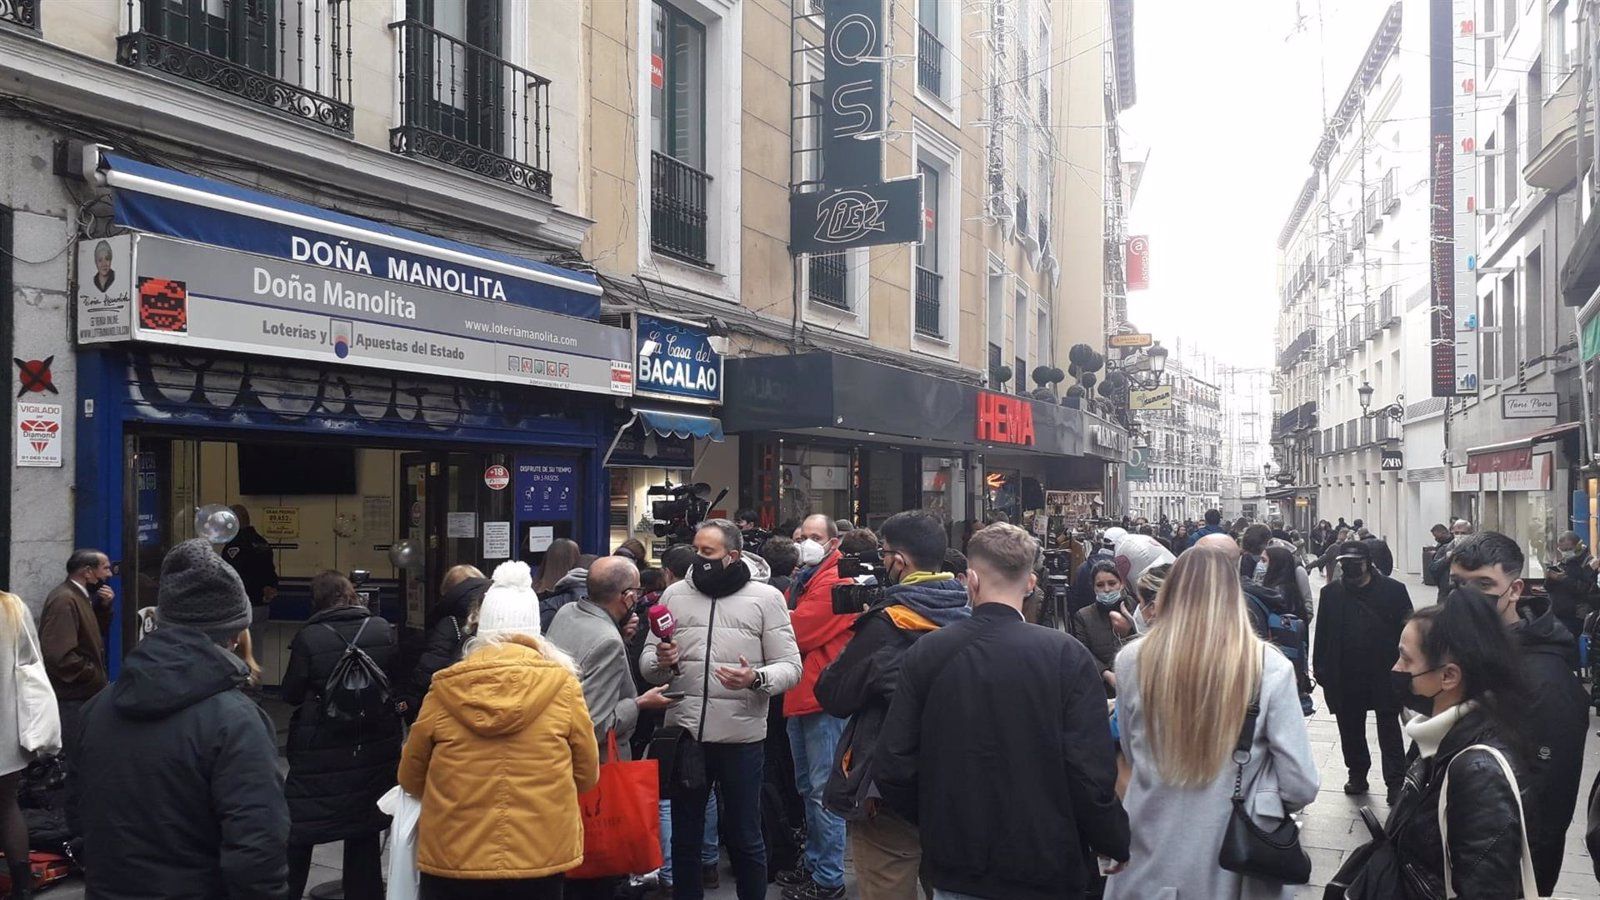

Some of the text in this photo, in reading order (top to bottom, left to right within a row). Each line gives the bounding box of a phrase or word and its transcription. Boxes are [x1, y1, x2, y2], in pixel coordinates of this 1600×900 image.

[1461, 137, 1474, 152] 10
[291, 236, 507, 301] DOÑA MANOLITA
[253, 267, 417, 320] Doña Manolita
[262, 320, 465, 360] Loterías y Apuestas del Estado
[464, 318, 578, 347] www.loteriamanolita.com
[666, 333, 692, 360] Casa
[639, 355, 717, 392] BACALAO
[20, 405, 60, 415] VIGILADO
[976, 390, 1035, 446] HEMA
[1530, 398, 1553, 408] Pons
